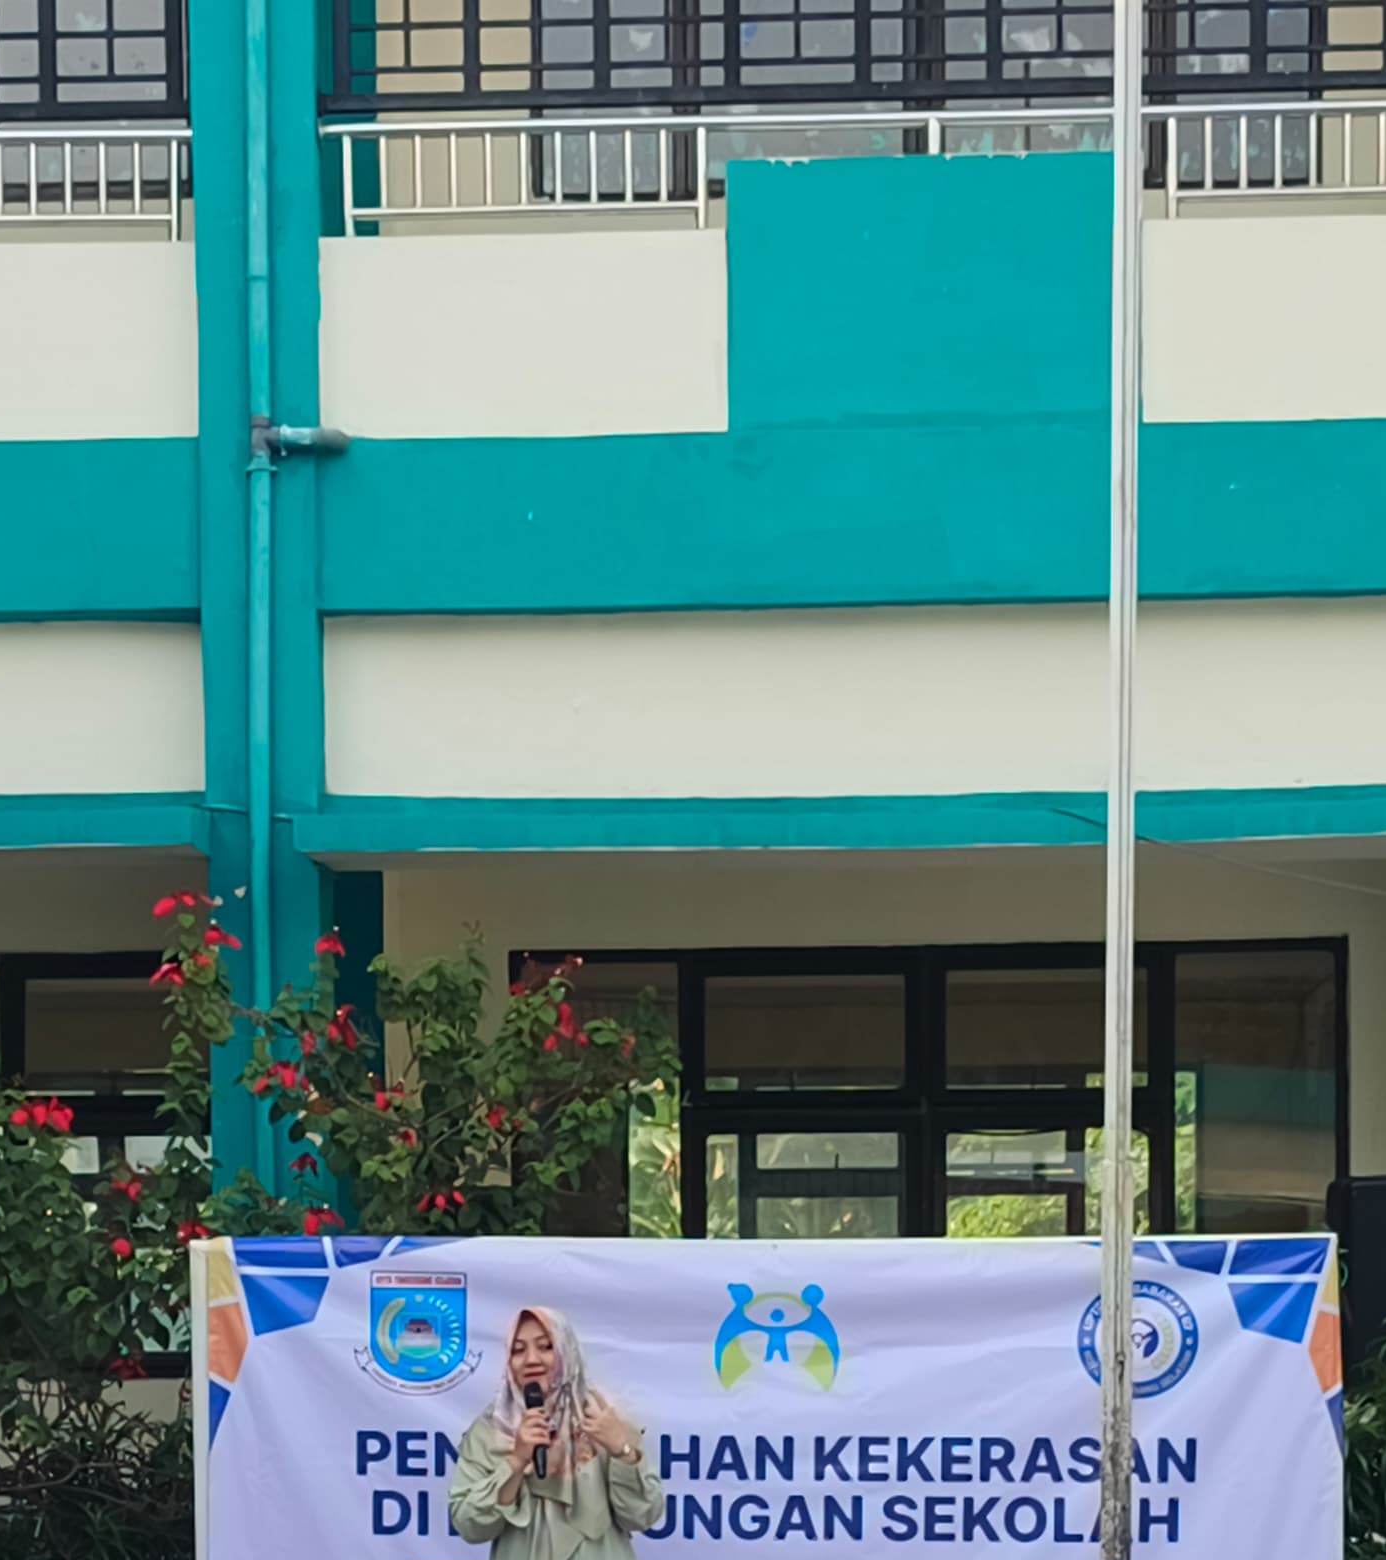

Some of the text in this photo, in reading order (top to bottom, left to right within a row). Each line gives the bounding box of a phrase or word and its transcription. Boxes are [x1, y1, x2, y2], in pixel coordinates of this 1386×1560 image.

[355, 1430, 795, 1482] PENHAN
[372, 1490, 429, 1537] DI
[881, 1494, 1180, 1544] SEKOLH
